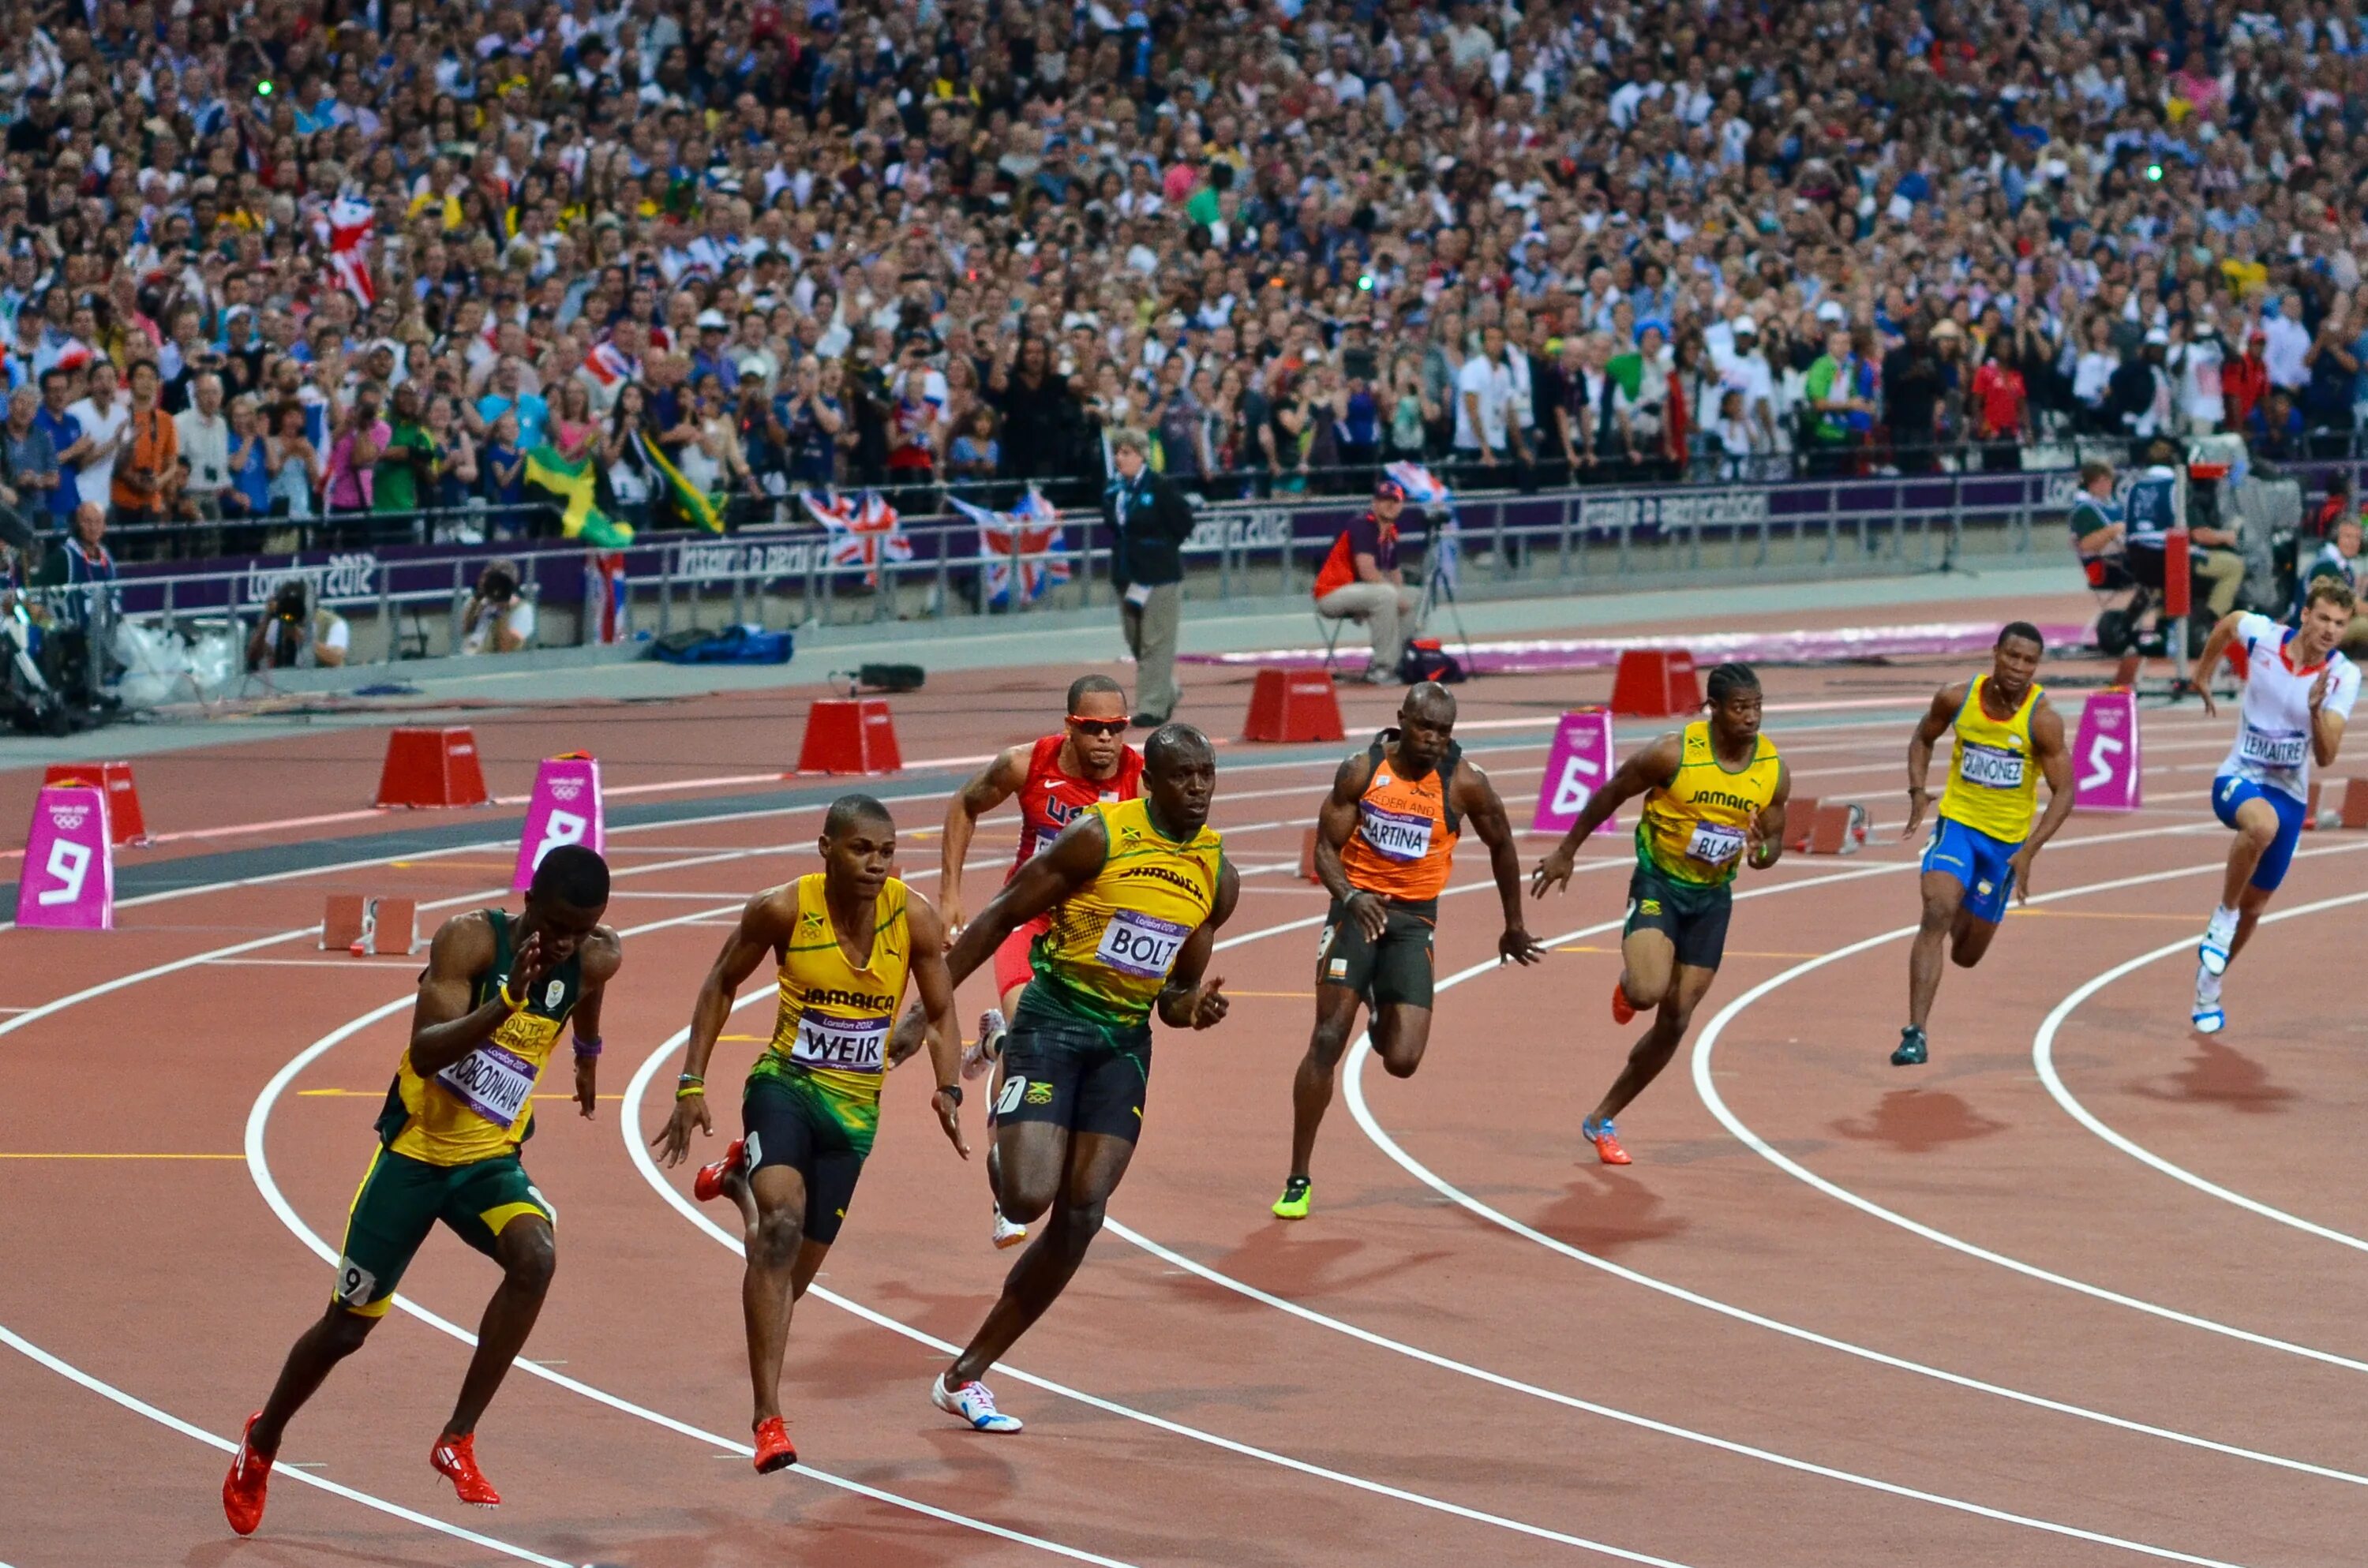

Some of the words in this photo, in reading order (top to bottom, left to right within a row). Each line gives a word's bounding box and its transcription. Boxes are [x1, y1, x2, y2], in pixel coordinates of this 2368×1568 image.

[328, 554, 376, 596] 2012
[2244, 733, 2302, 761] LEMAITRE
[2079, 734, 2123, 791] 5
[1551, 755, 1599, 815] 6
[532, 810, 586, 872] 8
[1697, 837, 1743, 859] BLA
[39, 838, 92, 905] 9
[1135, 915, 1161, 930] London
[1160, 922, 1177, 934] 2012
[1111, 927, 1178, 967] BOLT
[797, 988, 895, 1011] JAMAICA
[506, 1018, 545, 1035] OUTH
[823, 1017, 854, 1030] London
[855, 1020, 874, 1031] 2012
[487, 1046, 515, 1065] London
[512, 1057, 527, 1072] 2012
[805, 1027, 879, 1063] WEIR
[1000, 1081, 1018, 1110] 7
[346, 1267, 362, 1296] 9
